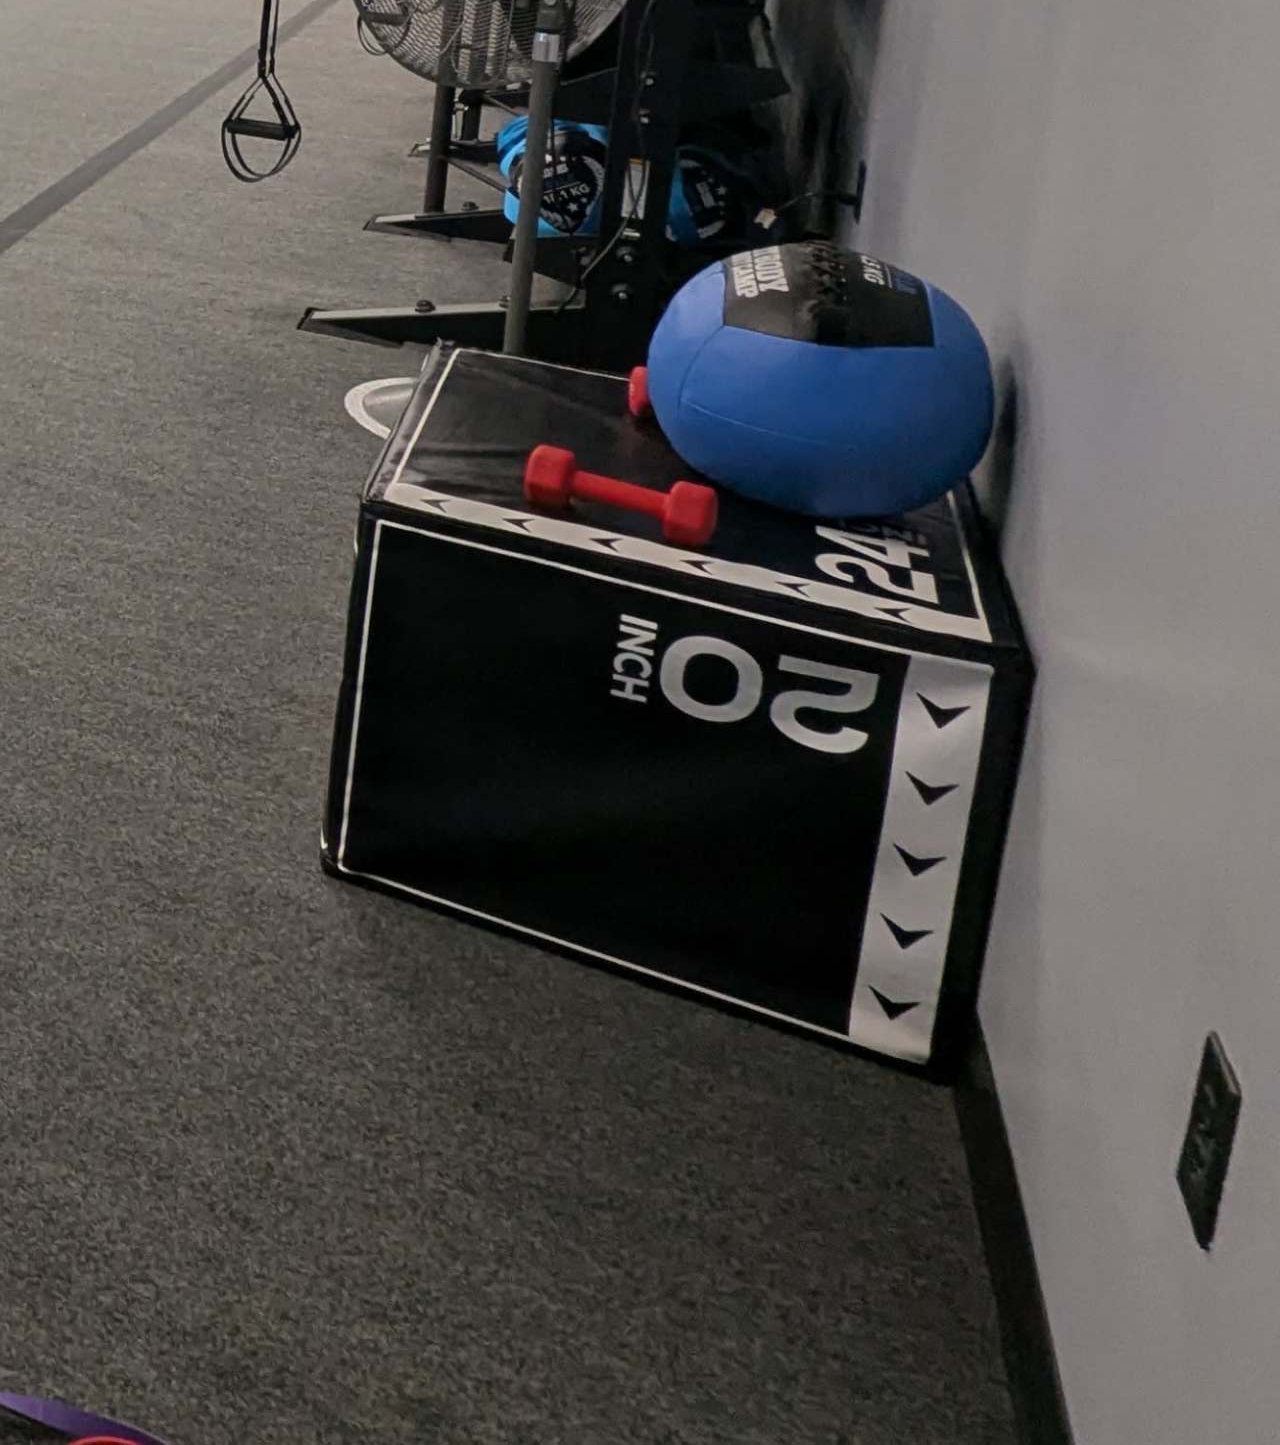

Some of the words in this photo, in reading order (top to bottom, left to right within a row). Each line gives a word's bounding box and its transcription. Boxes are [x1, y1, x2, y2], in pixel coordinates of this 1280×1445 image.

[569, 183, 591, 197] KG
[814, 525, 939, 604] 24
[610, 613, 659, 704] INCH
[660, 635, 880, 754] 20
